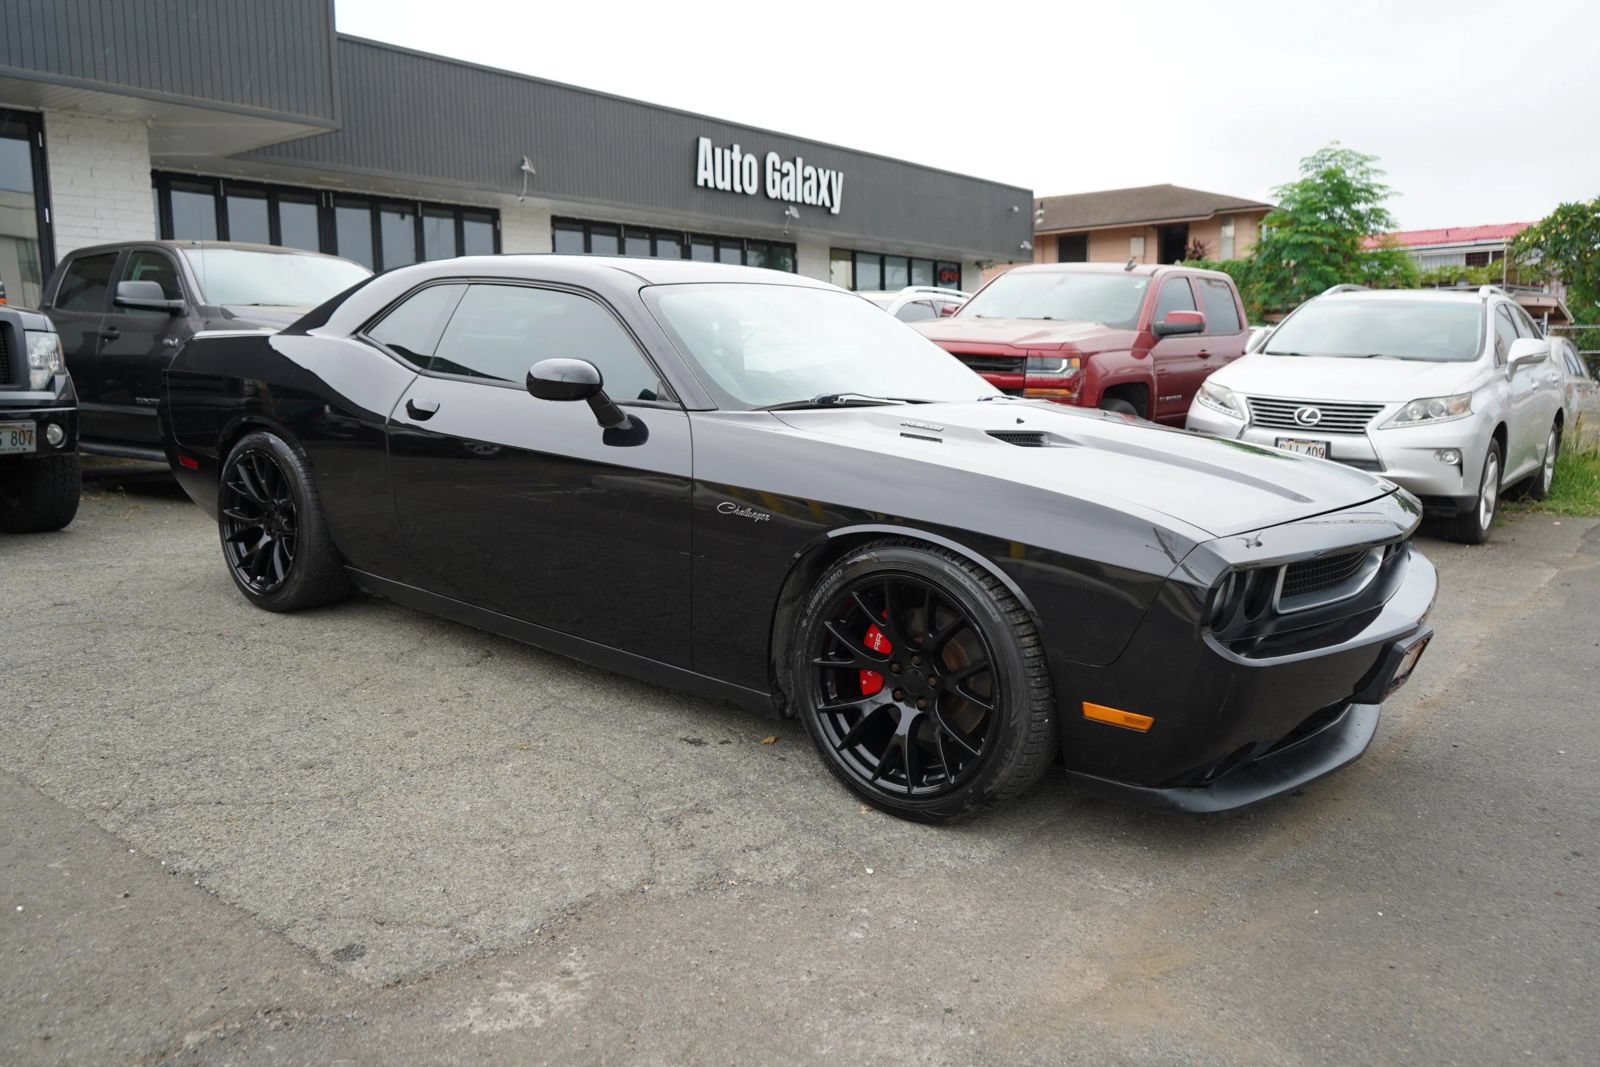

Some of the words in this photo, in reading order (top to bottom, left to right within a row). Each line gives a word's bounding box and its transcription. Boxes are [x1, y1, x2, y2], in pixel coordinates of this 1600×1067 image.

[697, 136, 759, 196] Auto
[764, 151, 844, 215] Galaxy
[10, 430, 33, 447] 807
[716, 501, 770, 522] Challenger
